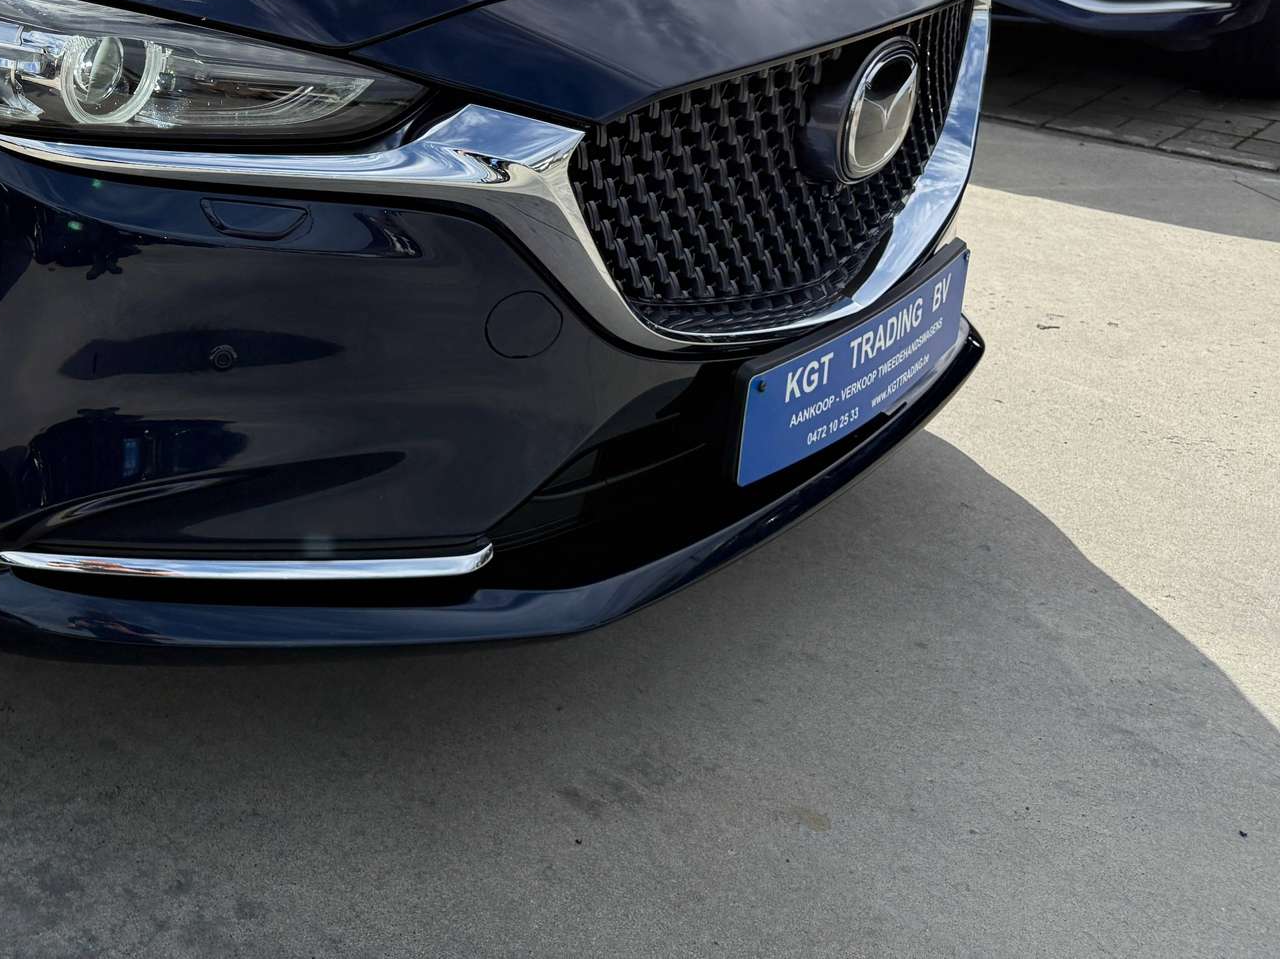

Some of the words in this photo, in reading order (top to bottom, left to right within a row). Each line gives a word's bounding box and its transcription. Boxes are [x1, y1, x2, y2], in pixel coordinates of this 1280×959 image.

[785, 351, 834, 403] KGT
[849, 297, 923, 369] TRADING
[932, 272, 952, 312] BV
[789, 394, 835, 428] AANKOOP
[840, 370, 878, 401] VERKOOP
[878, 317, 944, 377] TWEEDEHANDSWAGENS
[807, 425, 827, 446] 0472
[828, 418, 838, 433] 10
[839, 412, 849, 428] 25
[849, 406, 859, 423] 33
